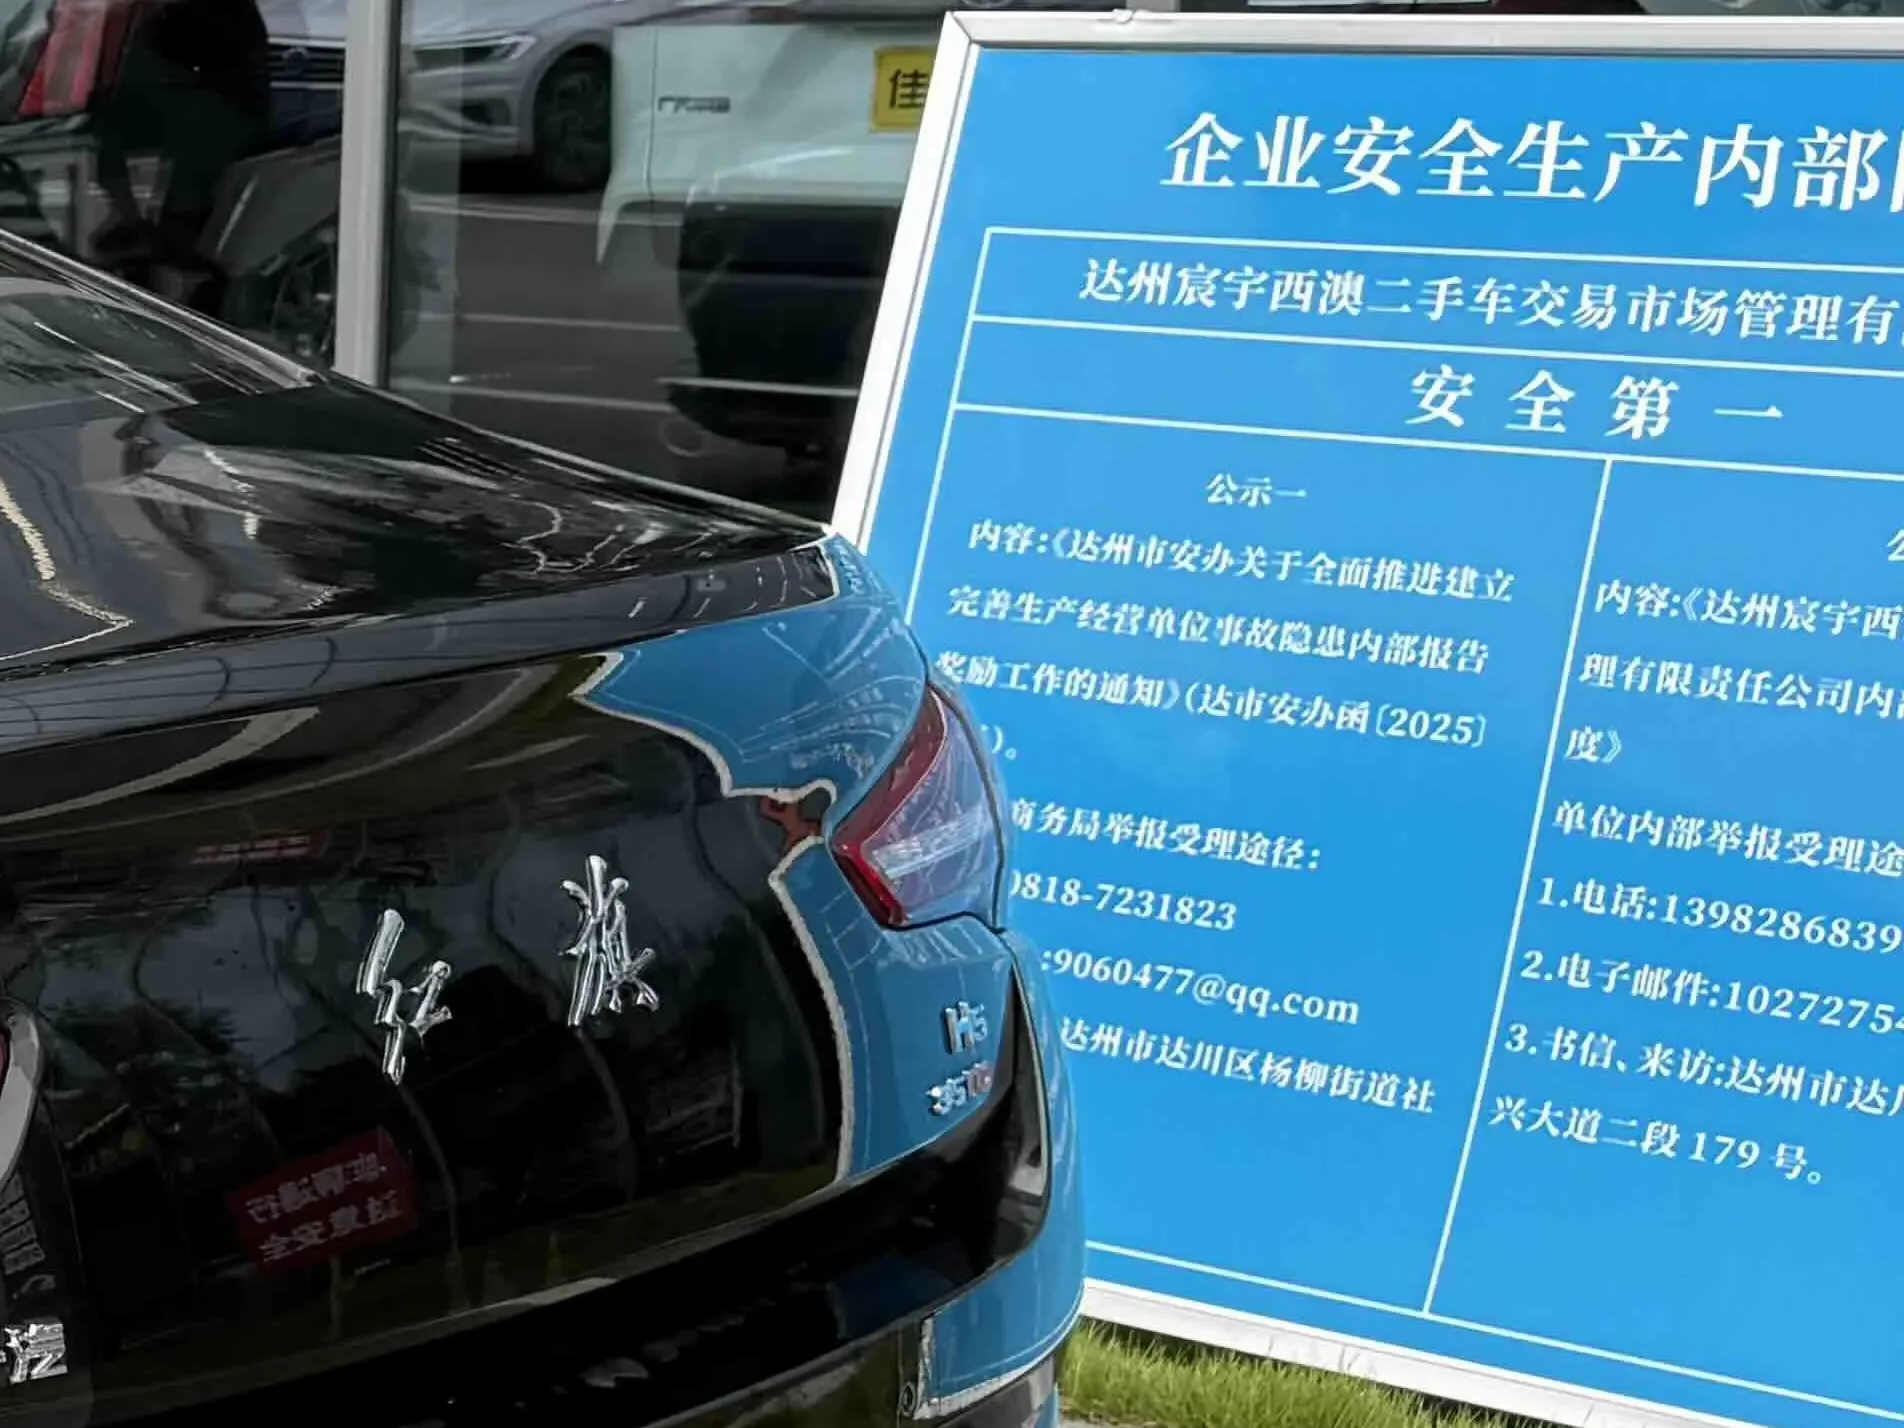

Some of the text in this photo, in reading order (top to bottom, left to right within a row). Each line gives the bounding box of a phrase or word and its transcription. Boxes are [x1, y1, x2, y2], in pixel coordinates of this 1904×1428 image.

[1159, 111, 1904, 214] 企业安全生产内部
[1079, 257, 1904, 346] 达州宸宇西澳二手车交易市场管理有
[1206, 472, 1307, 508] 公示一
[946, 584, 1490, 675] 完善生产经营单位事故隐患内部报告
[1578, 651, 1904, 719] 理有限责任公司内
[1552, 799, 1904, 879] 单位内部举报受理途
[939, 1000, 989, 1056] H5
[1059, 1016, 1438, 1114] 达州市达川区杨柳街道社
[1487, 1095, 1682, 1159] 兴大道二段
[1688, 1131, 1761, 1170] 179
